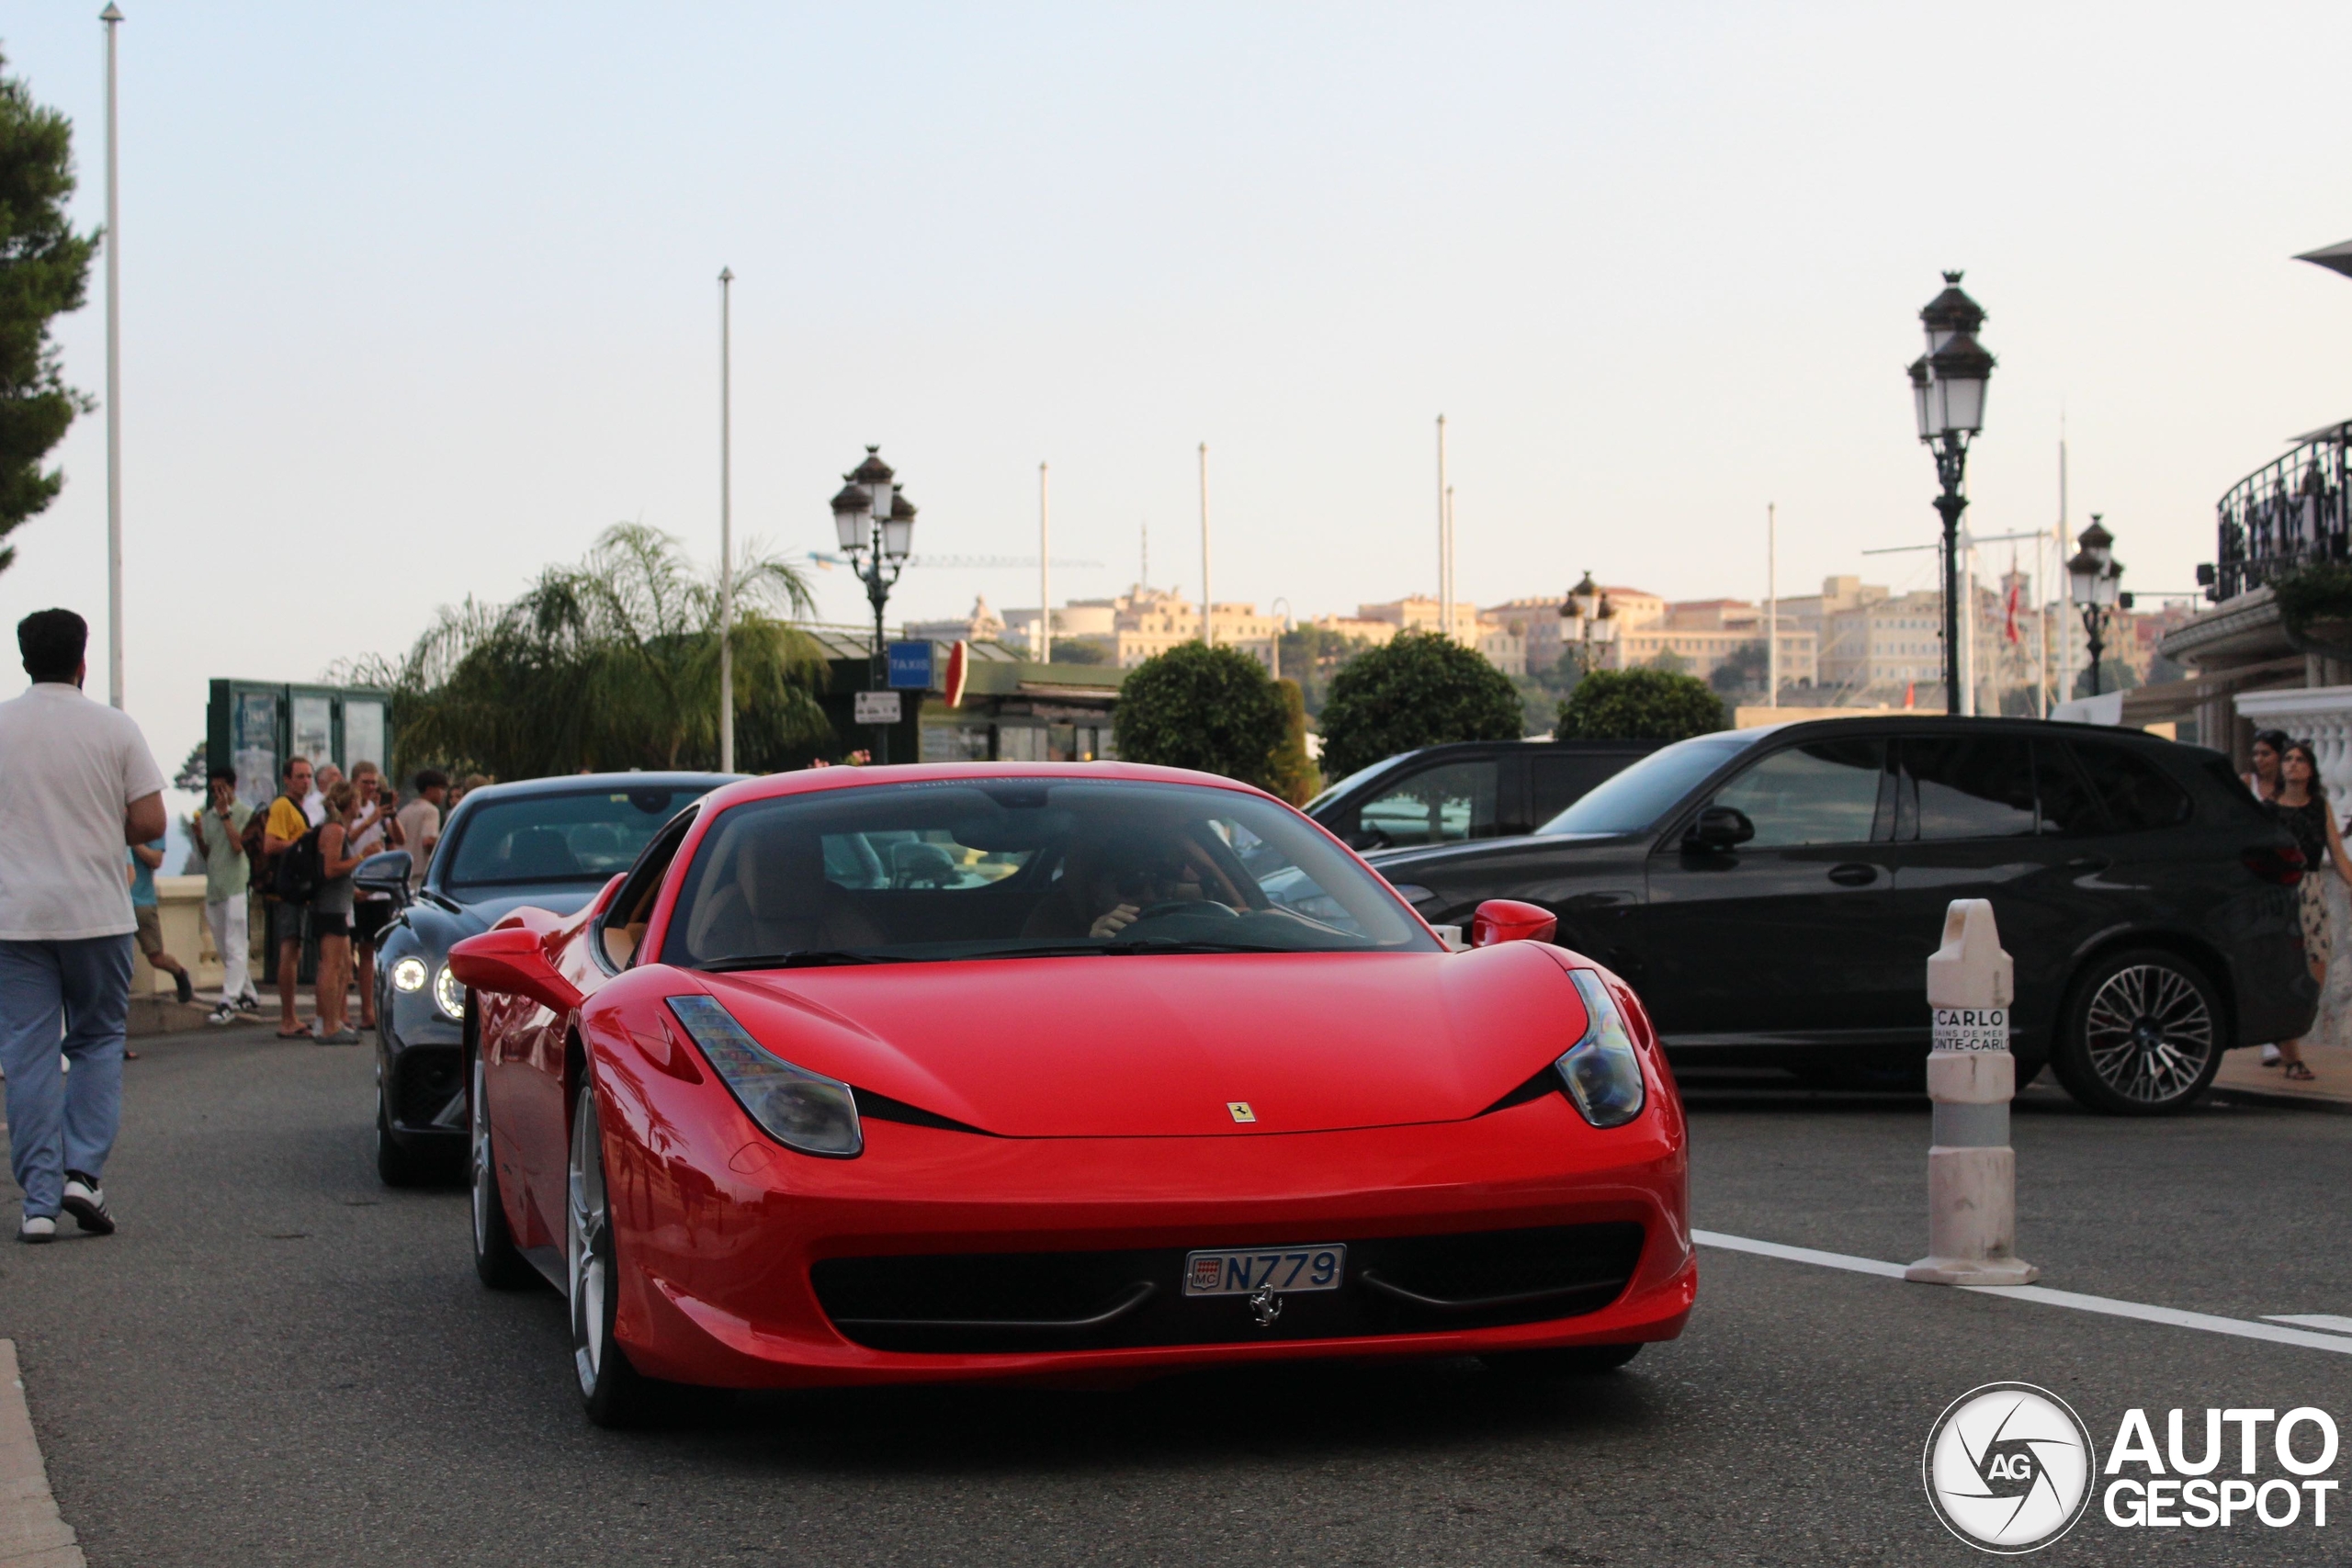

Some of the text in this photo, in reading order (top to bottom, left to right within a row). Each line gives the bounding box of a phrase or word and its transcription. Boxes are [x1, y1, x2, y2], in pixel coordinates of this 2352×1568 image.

[891, 659, 929, 671] TAXIS
[1963, 1030, 1978, 1038] DE
[1984, 1030, 2003, 1038] MER
[1194, 1252, 1337, 1291] MC N779
